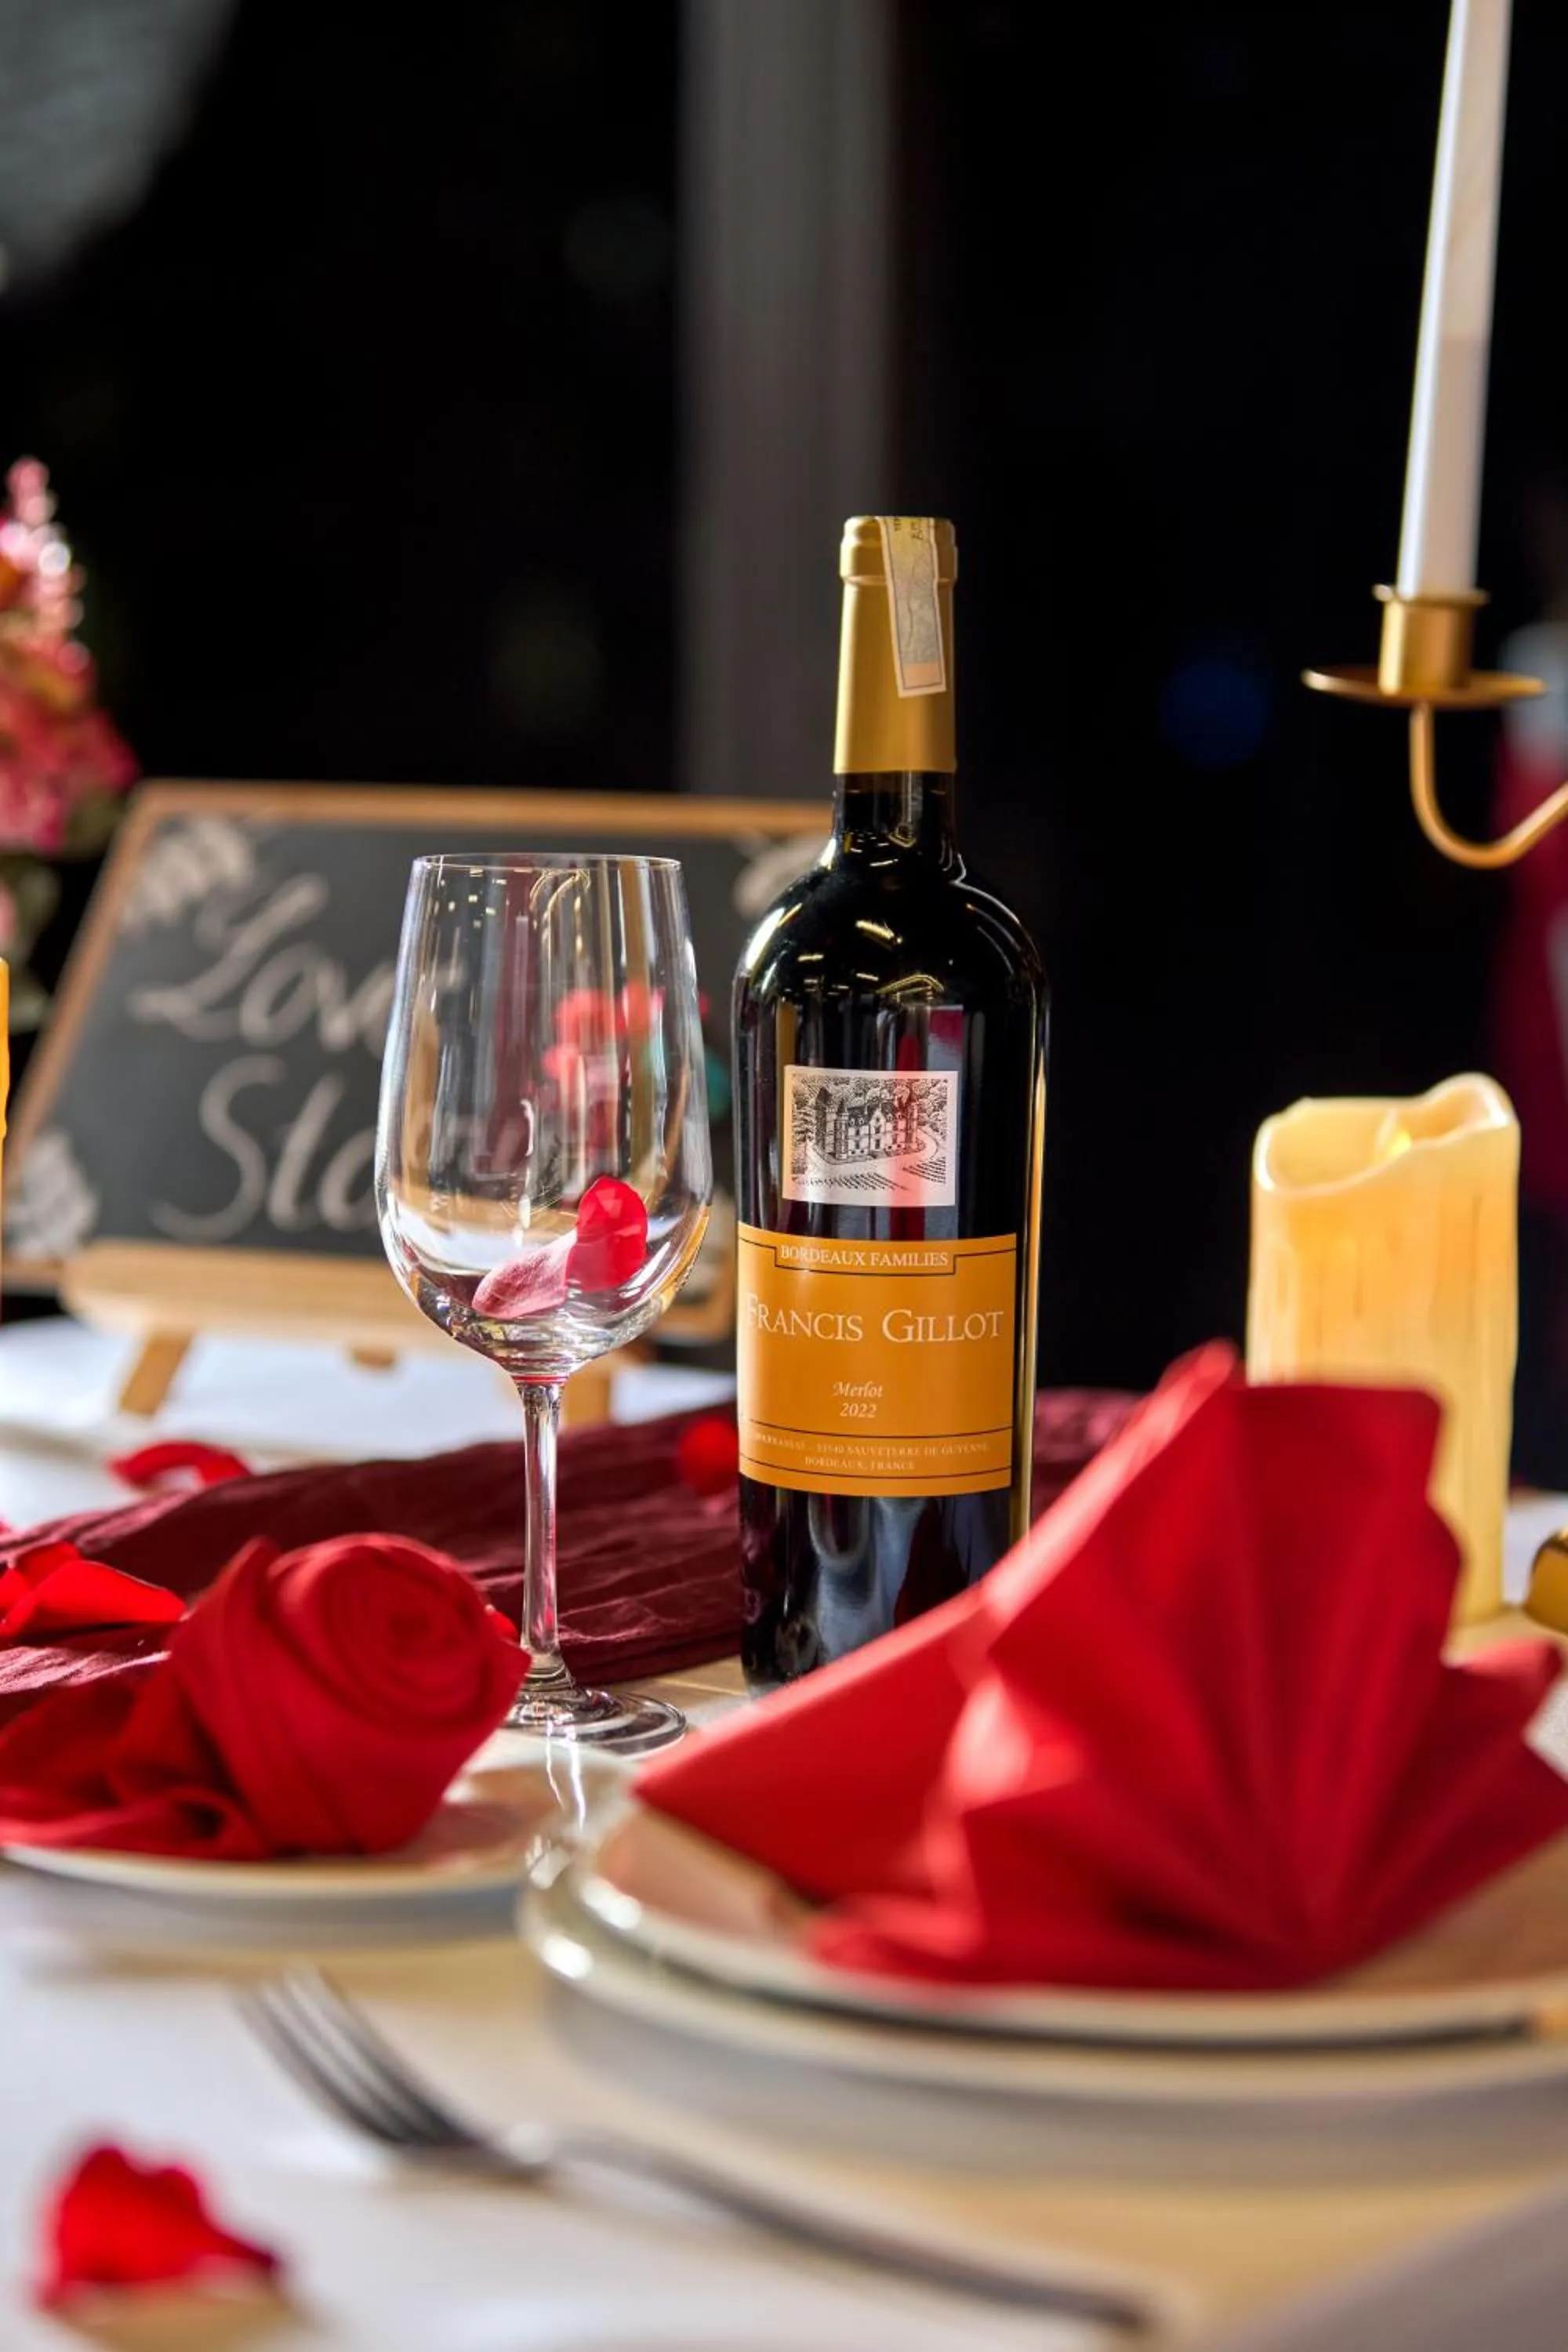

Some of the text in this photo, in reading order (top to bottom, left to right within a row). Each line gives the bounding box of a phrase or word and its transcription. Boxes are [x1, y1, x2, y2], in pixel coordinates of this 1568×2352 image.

[781, 1244, 949, 1268] BORDEAUX FAMILIES
[747, 1294, 1004, 1343] FRANCIS GILLOT
[833, 1381, 884, 1398] Merlot
[840, 1402, 877, 1418] 2022
[871, 1461, 916, 1472] FRANCE
